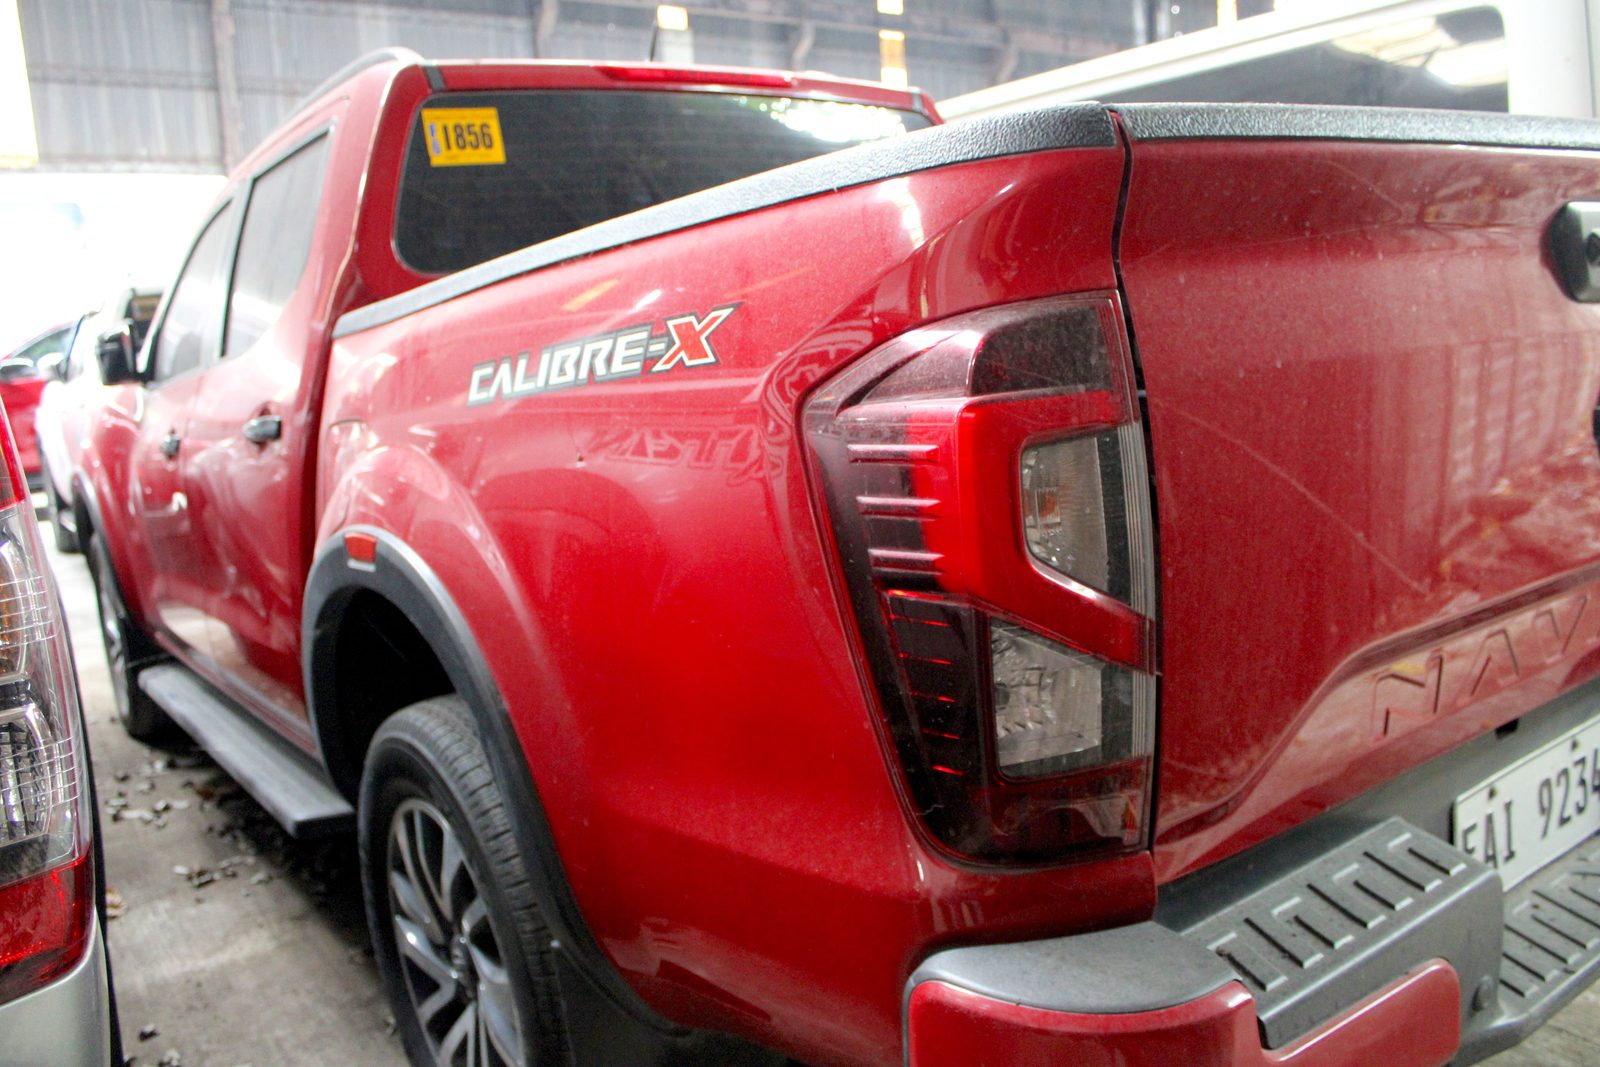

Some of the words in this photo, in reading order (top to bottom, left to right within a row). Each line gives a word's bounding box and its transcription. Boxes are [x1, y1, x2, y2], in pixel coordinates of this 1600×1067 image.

[442, 123, 493, 150] 1856
[467, 301, 743, 406] CALIBRE-X
[1372, 594, 1600, 741] NAV
